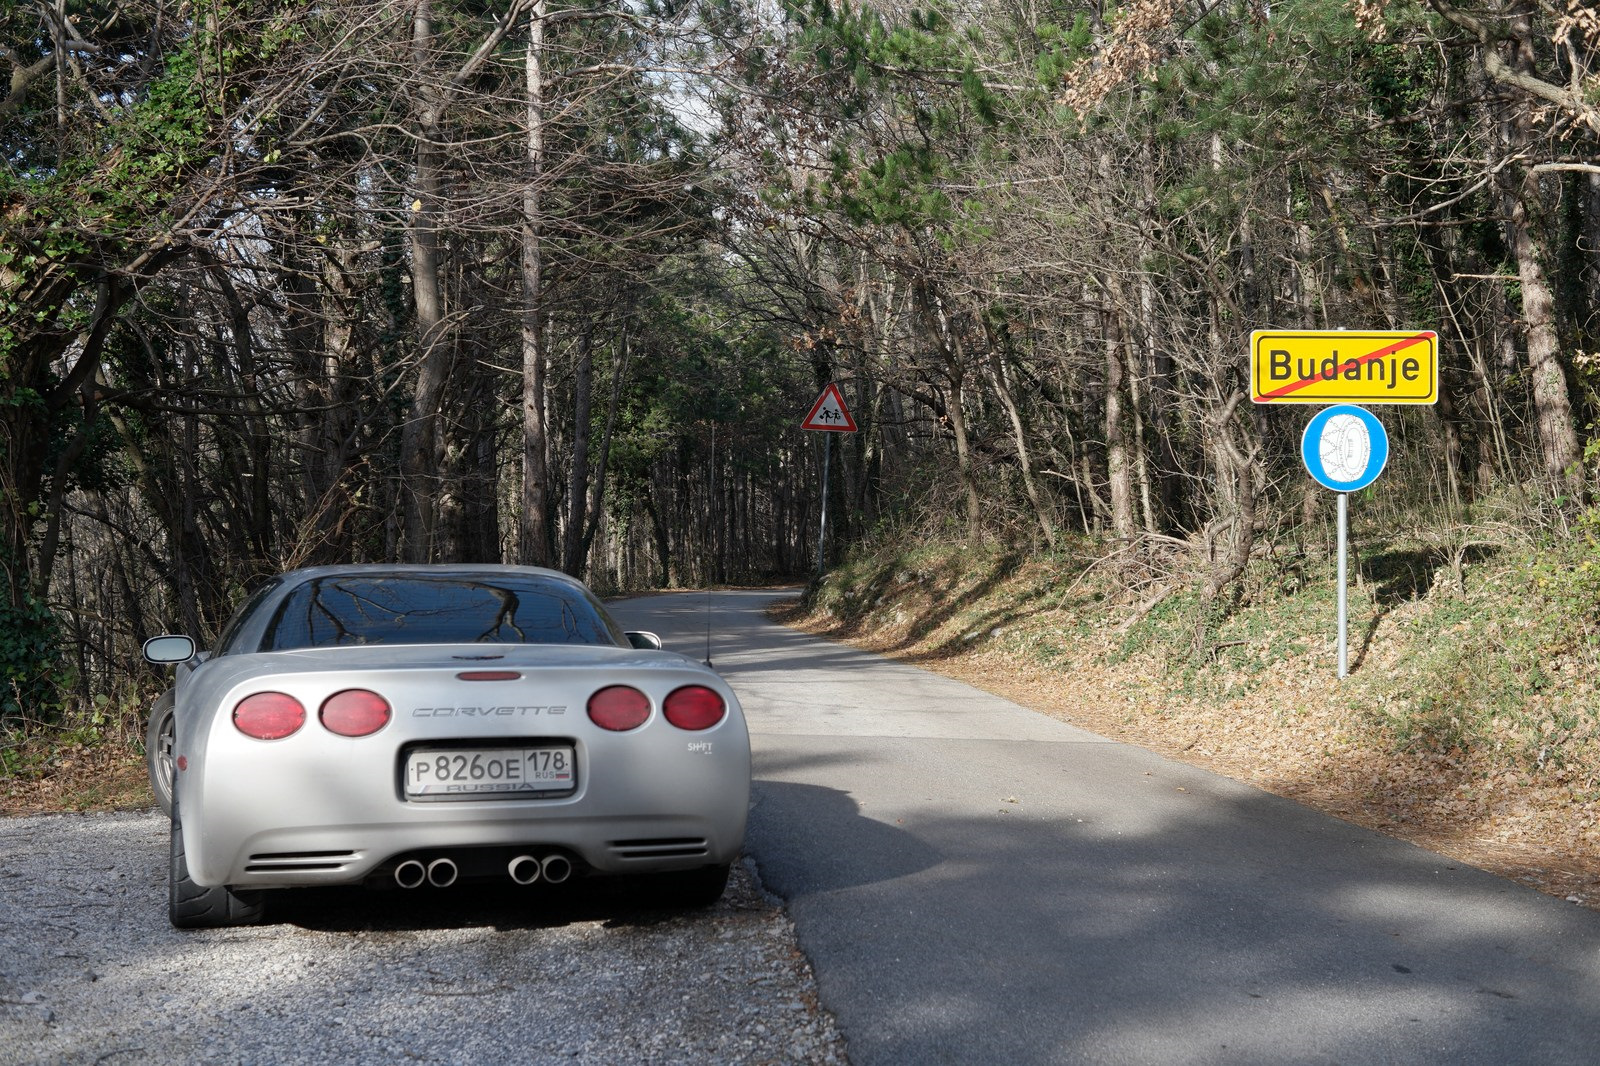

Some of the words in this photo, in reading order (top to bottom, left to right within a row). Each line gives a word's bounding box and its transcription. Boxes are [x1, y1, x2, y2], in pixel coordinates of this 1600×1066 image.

[1270, 350, 1420, 389] Budanje
[412, 705, 567, 718] CORVETTE
[527, 751, 565, 772] 178
[535, 771, 555, 779] RUS
[446, 783, 535, 792] RUSSIA
